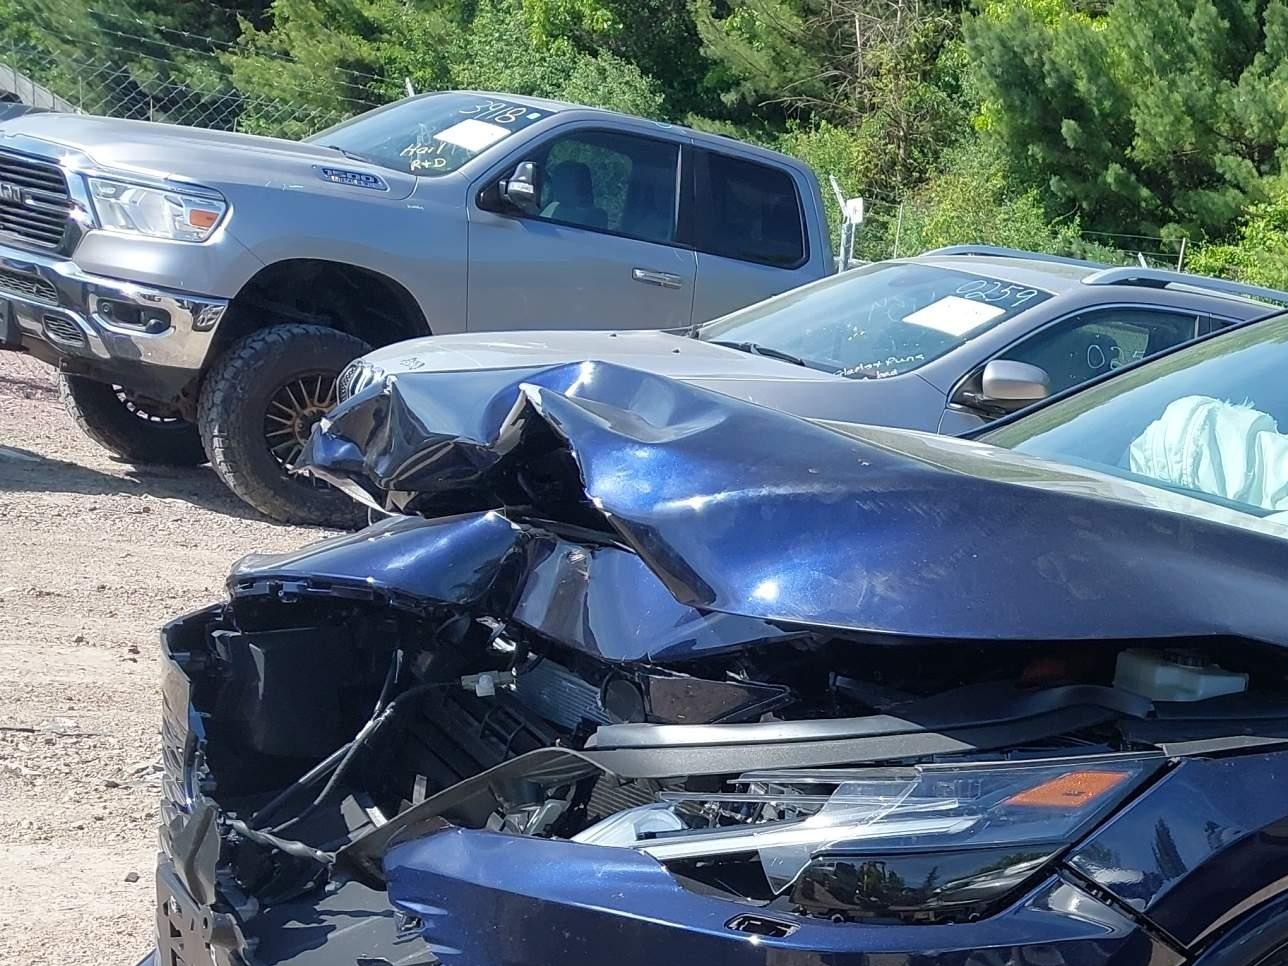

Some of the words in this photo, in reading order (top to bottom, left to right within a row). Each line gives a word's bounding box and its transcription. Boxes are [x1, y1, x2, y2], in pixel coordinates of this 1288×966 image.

[459, 100, 526, 123] 3918
[400, 142, 447, 157] Hail
[956, 279, 1039, 307] 0259
